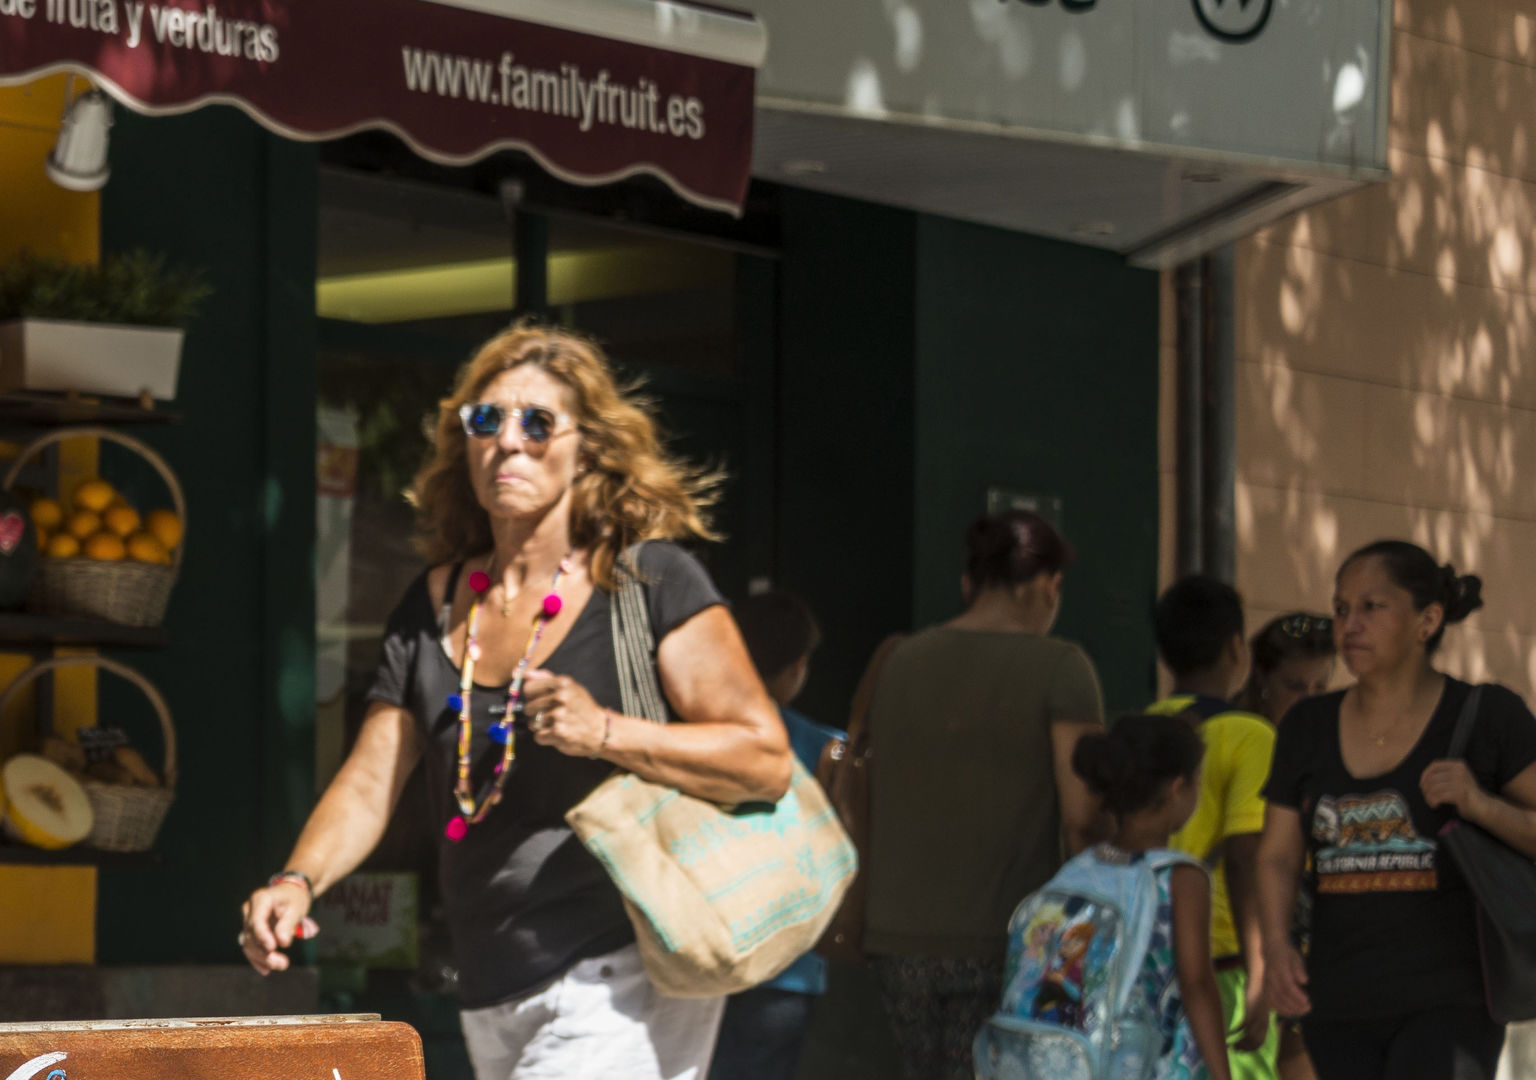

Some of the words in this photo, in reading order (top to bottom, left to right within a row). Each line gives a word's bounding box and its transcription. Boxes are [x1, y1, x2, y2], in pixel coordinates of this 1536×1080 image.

[125, 2, 146, 48] y
[148, 11, 280, 63] verduras
[401, 45, 706, 140] www.familyfruit.es
